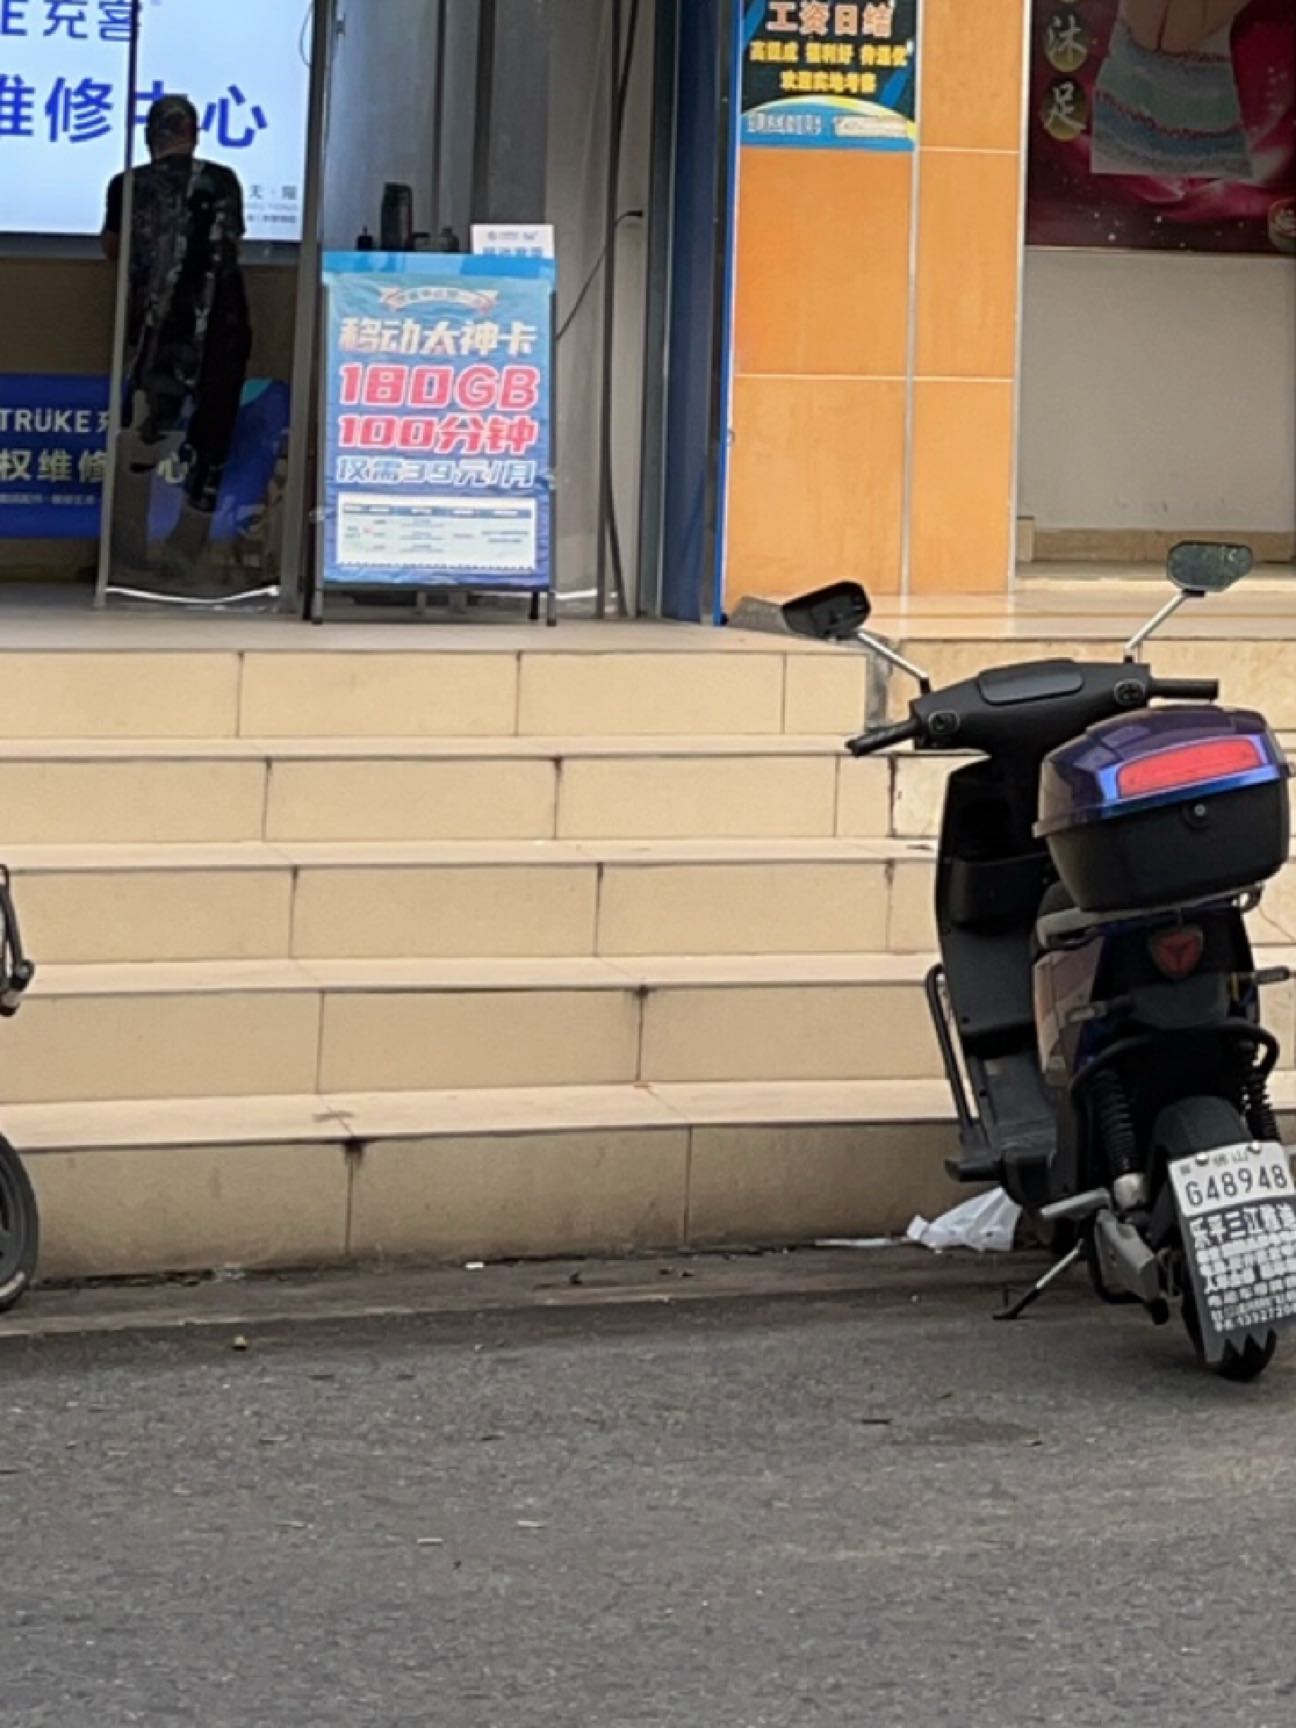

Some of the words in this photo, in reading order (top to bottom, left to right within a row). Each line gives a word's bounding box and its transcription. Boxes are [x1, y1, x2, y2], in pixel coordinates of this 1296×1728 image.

[765, 0, 894, 38] 工资日结
[339, 317, 537, 356] 移动大神卡
[338, 364, 540, 411] 180GB
[338, 415, 539, 455] 100分钟
